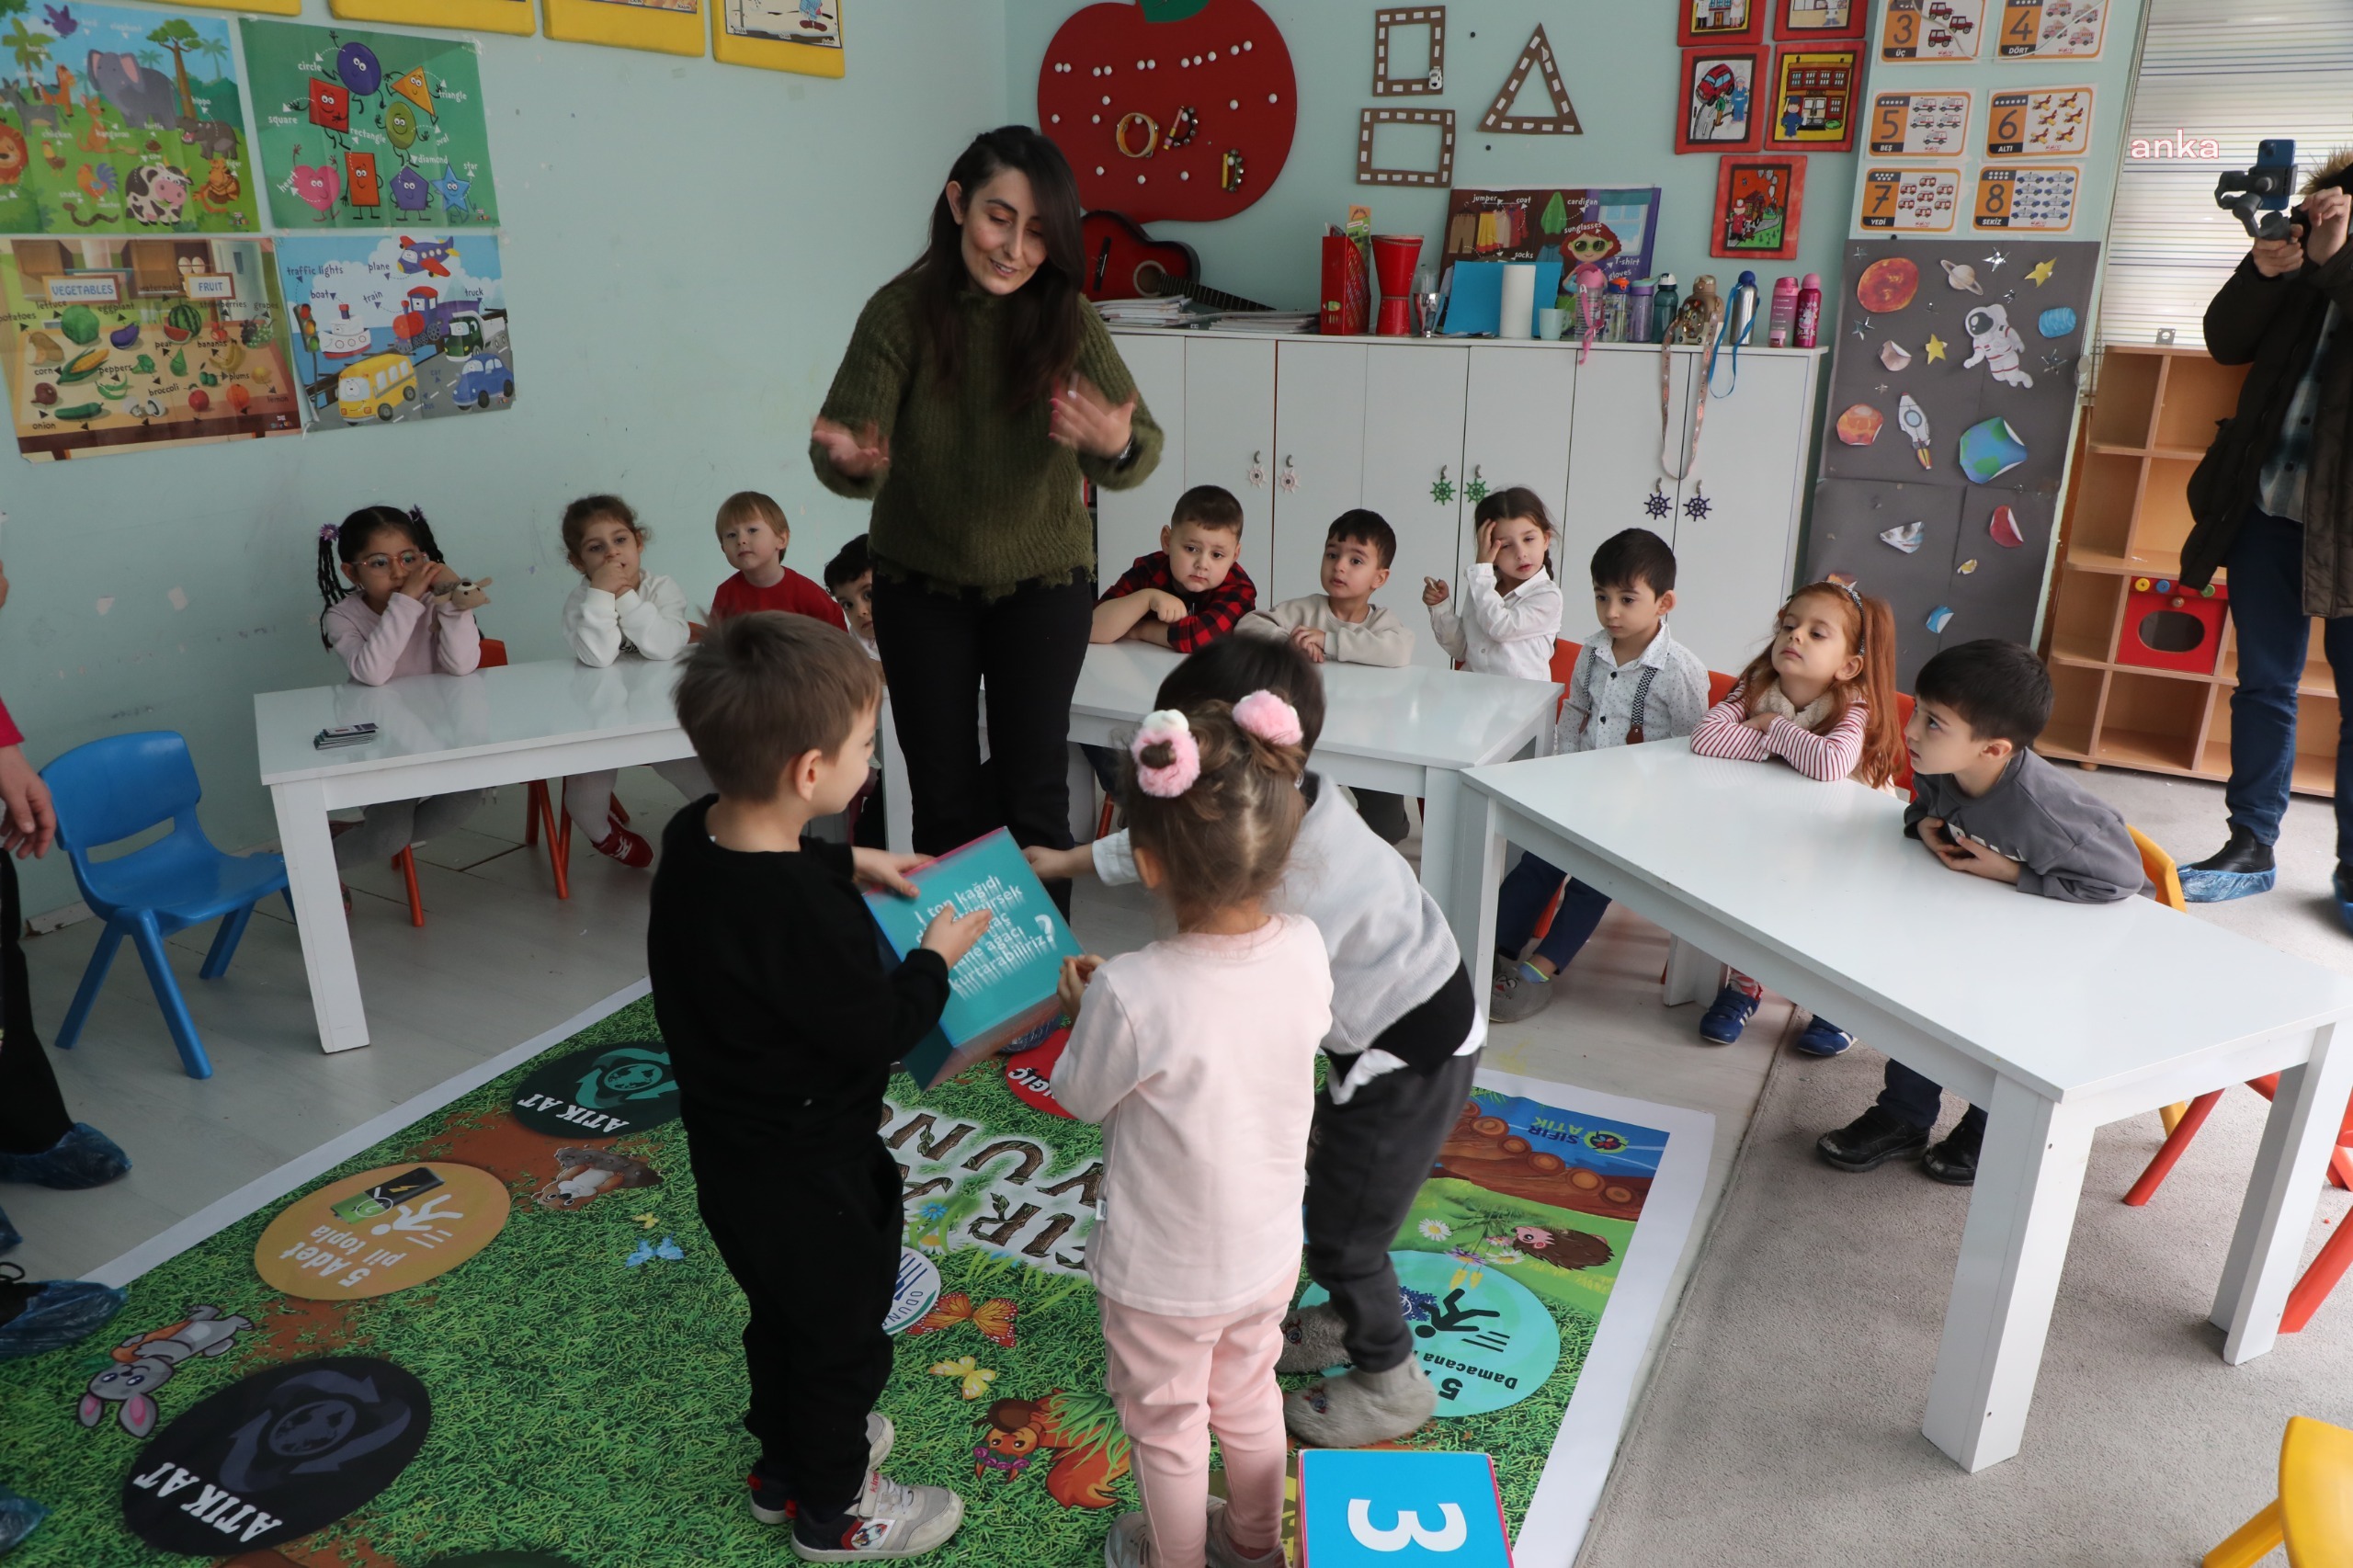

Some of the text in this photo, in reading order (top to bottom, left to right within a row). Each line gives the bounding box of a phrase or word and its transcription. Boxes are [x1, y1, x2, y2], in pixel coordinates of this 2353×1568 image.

[1893, 14, 1913, 44] 3
[2009, 9, 2033, 41] 4
[26, 41, 50, 53] horse
[1895, 49, 1906, 57] ÜÇ
[2008, 47, 2029, 55] DÖRT
[297, 61, 323, 72] circle
[190, 95, 211, 108] hippo
[438, 89, 468, 103] triangle
[267, 115, 298, 127] square
[1881, 109, 1900, 140] 5
[1997, 108, 2018, 140] 6
[41, 129, 73, 139] chicken
[95, 129, 130, 141] kangaroo
[350, 128, 386, 145] rectangle
[436, 132, 450, 147] oval
[148, 153, 162, 161] cow
[418, 153, 449, 165] diamond
[463, 161, 478, 170] star
[277, 171, 299, 193] heart
[1472, 194, 1498, 203] jumper
[1517, 196, 1531, 204] coat
[1567, 198, 1598, 208] cardigan
[1871, 185, 1892, 213] 7
[1985, 183, 2005, 213] 8
[1563, 222, 1602, 234] sunglasses
[1982, 218, 2003, 226] SEKİZ
[1615, 256, 1639, 266] T-shirt
[287, 264, 344, 278] traffic lights
[368, 262, 391, 274] plane
[1609, 268, 1631, 281] gloves
[51, 284, 114, 296] VEGETABLES
[198, 281, 223, 291] FRUIT
[310, 290, 329, 300] boat
[362, 290, 383, 303] train
[464, 288, 484, 297] truck
[35, 300, 67, 310] lettuce
[97, 301, 134, 314] eggplant
[199, 301, 247, 309] strawberries
[253, 301, 279, 312] grapes
[154, 341, 173, 350] pear
[98, 364, 133, 377] peppers
[229, 373, 250, 382] plums
[148, 385, 179, 396] broccoli
[267, 395, 289, 403] lemon
[424, 403, 435, 411] bus
[32, 422, 56, 430] onion
[953, 874, 1004, 905] kağıdı
[985, 926, 1026, 951] ağacı
[517, 1093, 631, 1133] ATIK AT
[1530, 1116, 1584, 1135] ATIK
[1527, 1125, 1580, 1145] SIFIR
[310, 1225, 408, 1267] pil topla
[279, 1242, 370, 1288] 5 Adet
[1423, 1352, 1518, 1391] Damacana
[1438, 1377, 1463, 1402] 5
[132, 1461, 283, 1543] ATIK AT
[1347, 1497, 1468, 1552] 3
